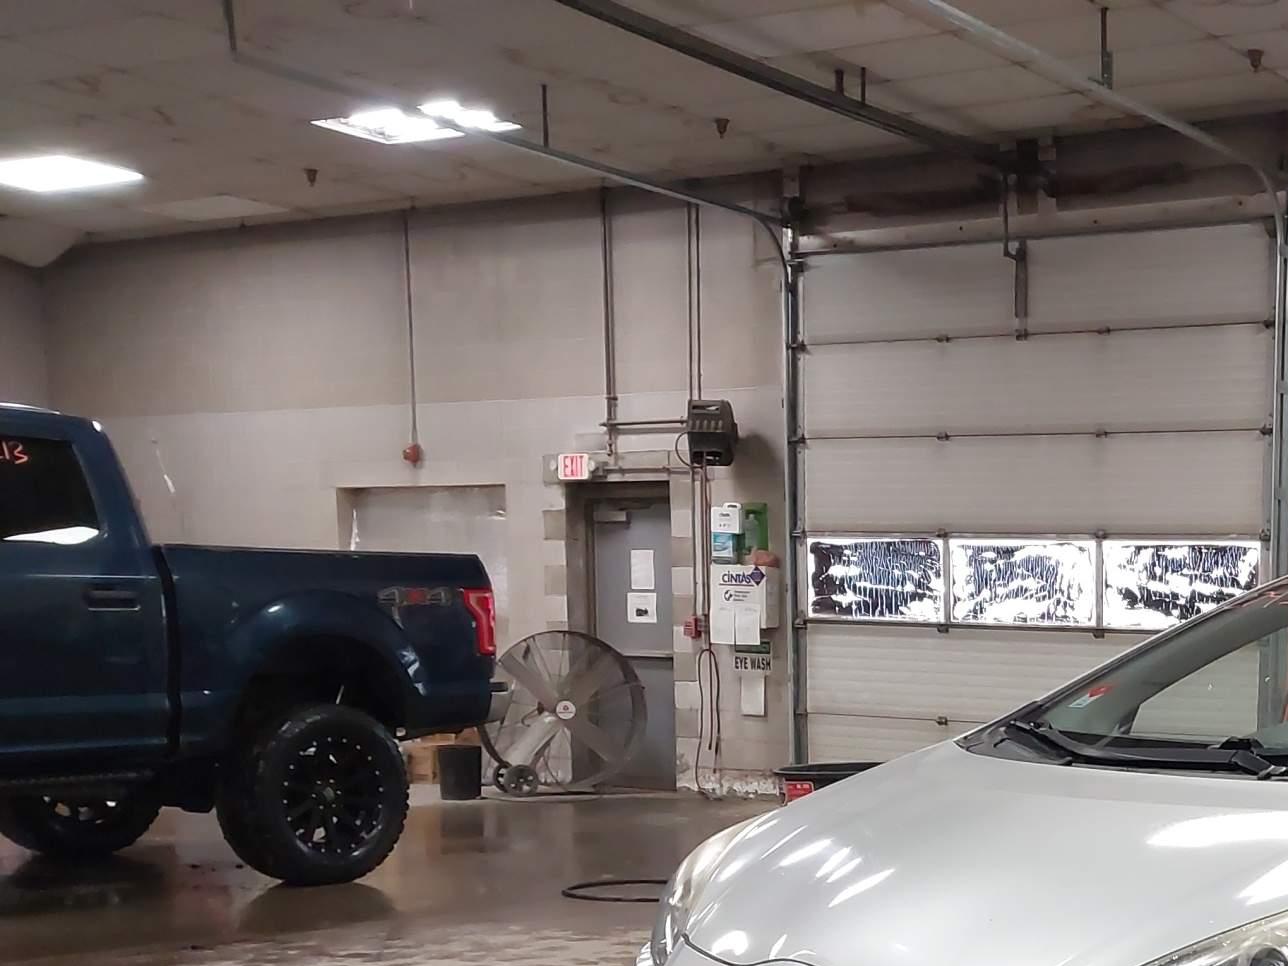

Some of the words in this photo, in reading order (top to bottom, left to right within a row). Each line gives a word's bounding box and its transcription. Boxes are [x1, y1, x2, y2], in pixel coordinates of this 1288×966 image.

[563, 455, 584, 478] EXIT
[734, 656, 748, 670] EYE
[750, 656, 771, 671] WASH
